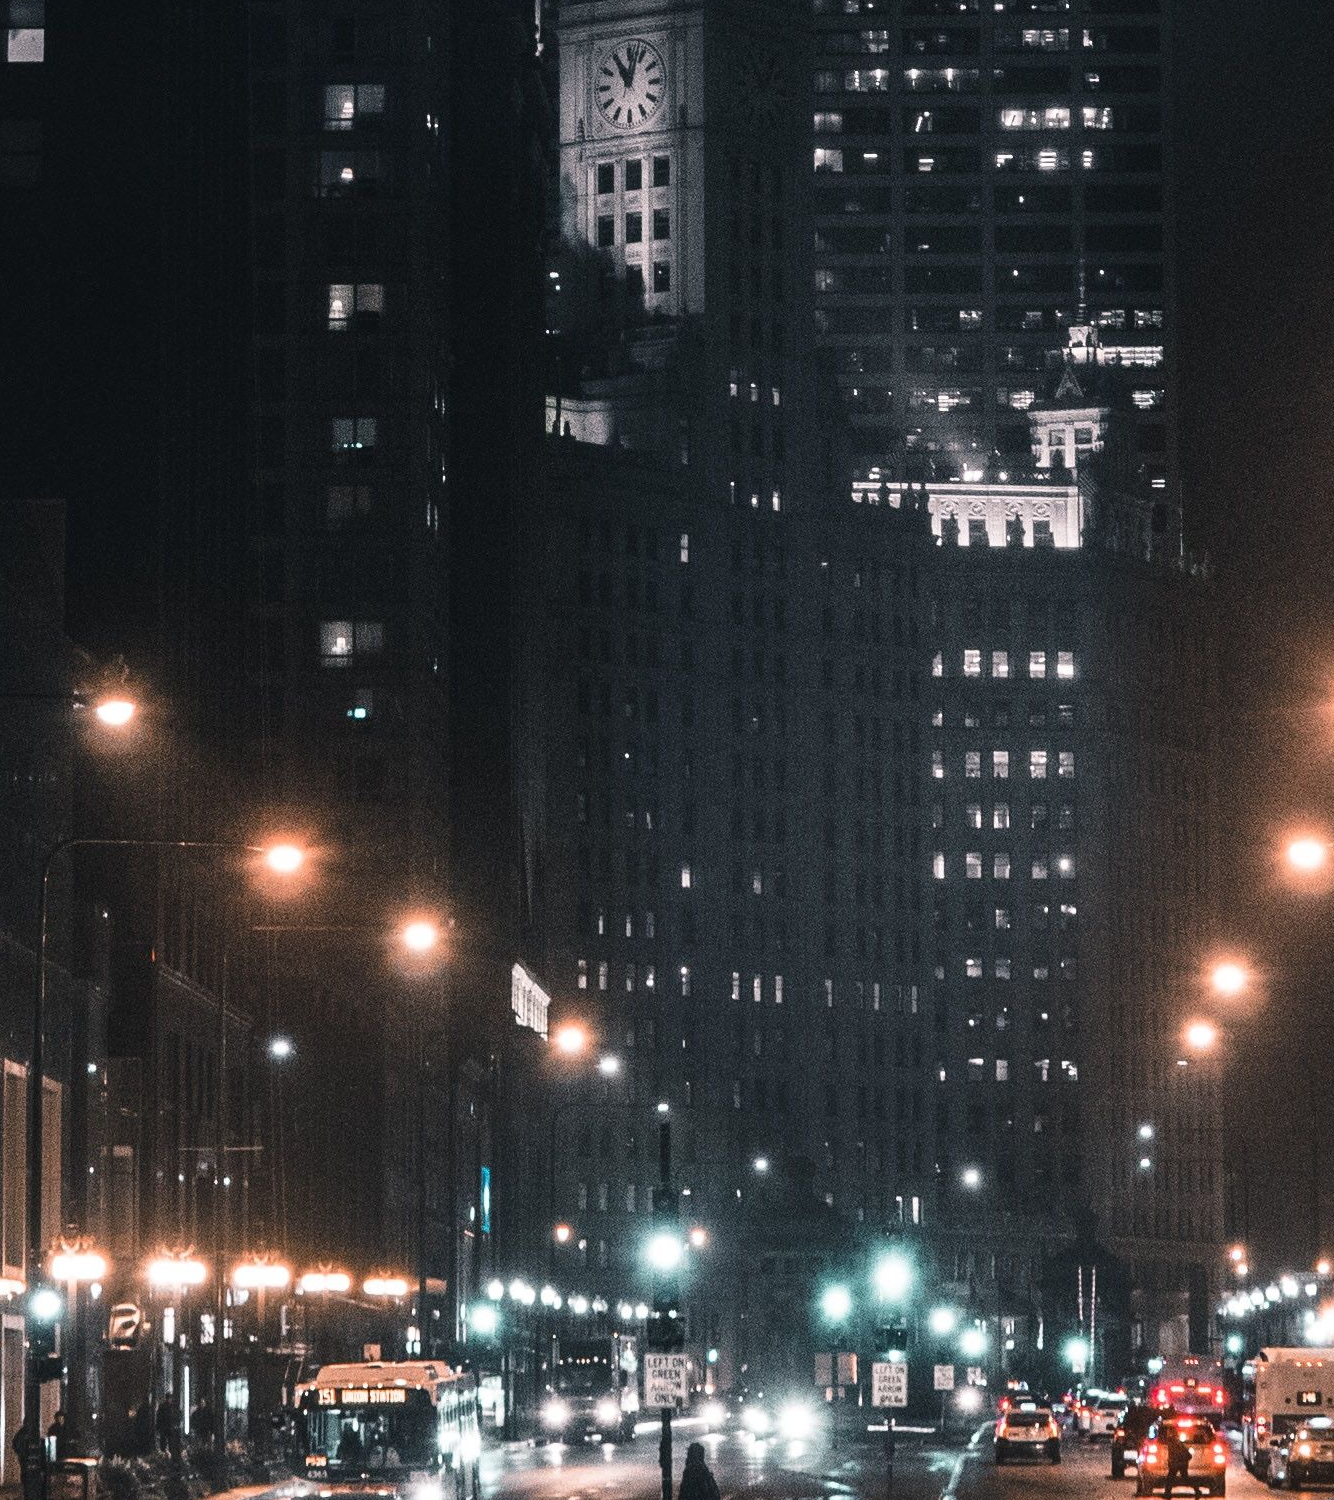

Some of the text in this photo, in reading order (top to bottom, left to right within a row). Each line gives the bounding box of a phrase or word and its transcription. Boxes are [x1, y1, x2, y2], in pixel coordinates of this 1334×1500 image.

[647, 1357, 685, 1369] LEFT ON
[652, 1369, 681, 1380] GREEN
[318, 1388, 406, 1406] 151 UNION STATION
